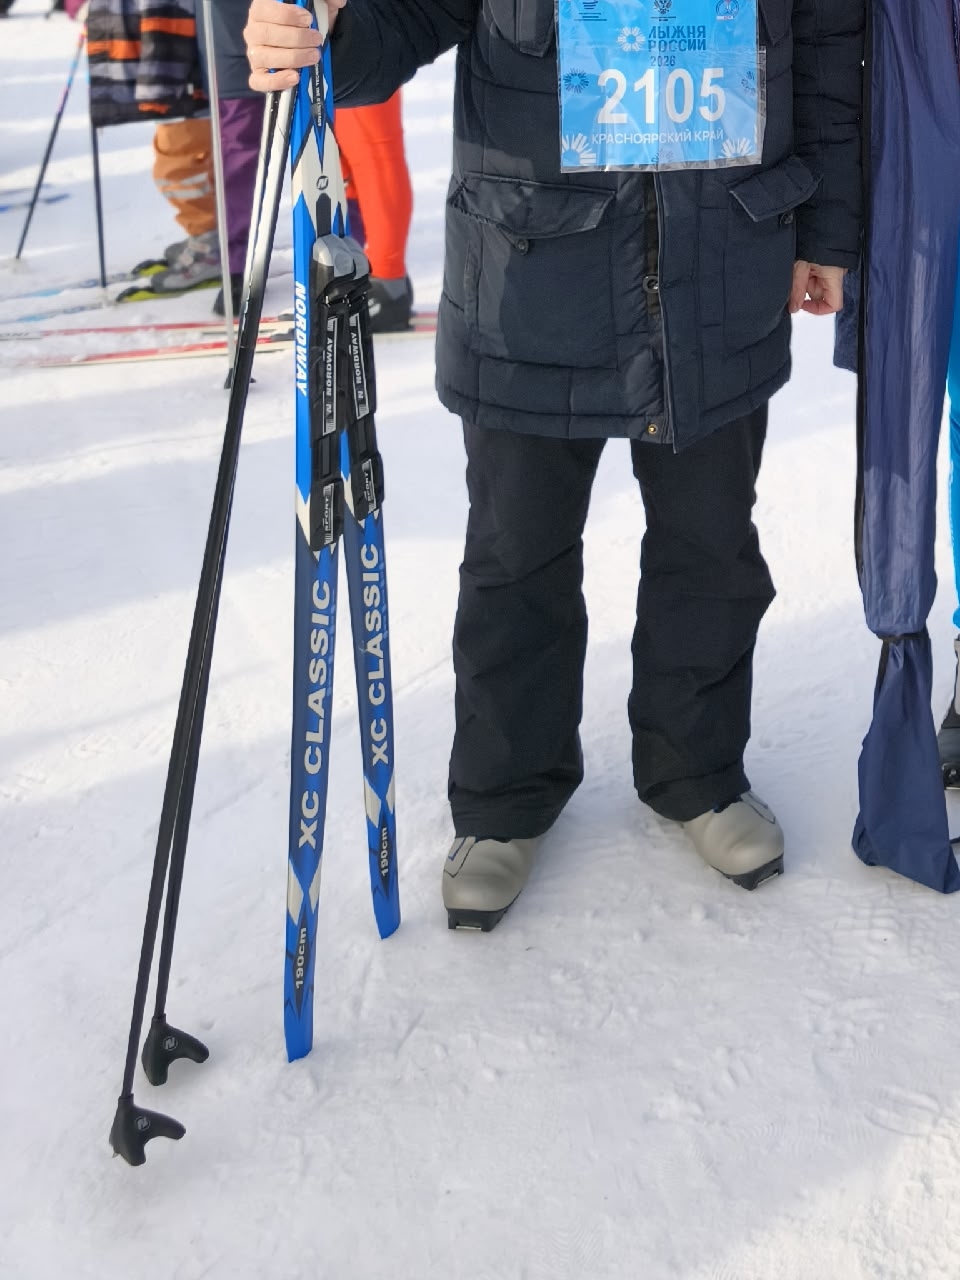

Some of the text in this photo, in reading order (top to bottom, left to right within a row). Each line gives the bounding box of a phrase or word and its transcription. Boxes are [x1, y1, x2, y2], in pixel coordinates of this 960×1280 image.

[648, 25, 707, 39] ЛЫЖНЯ
[648, 38, 707, 53] РОССИИ
[650, 55, 676, 67] 2026
[597, 67, 726, 124] 2105
[592, 129, 724, 145] КРАСНОЯРСКИЙ КРАЙ
[295, 280, 307, 397] NORDWAY
[350, 332, 362, 384] NORDWAY
[325, 337, 334, 398] NORDWAY
[360, 543, 389, 766] XC CLASSIC
[299, 580, 330, 849] XC CLASSIC
[296, 927, 307, 989] 190cm
